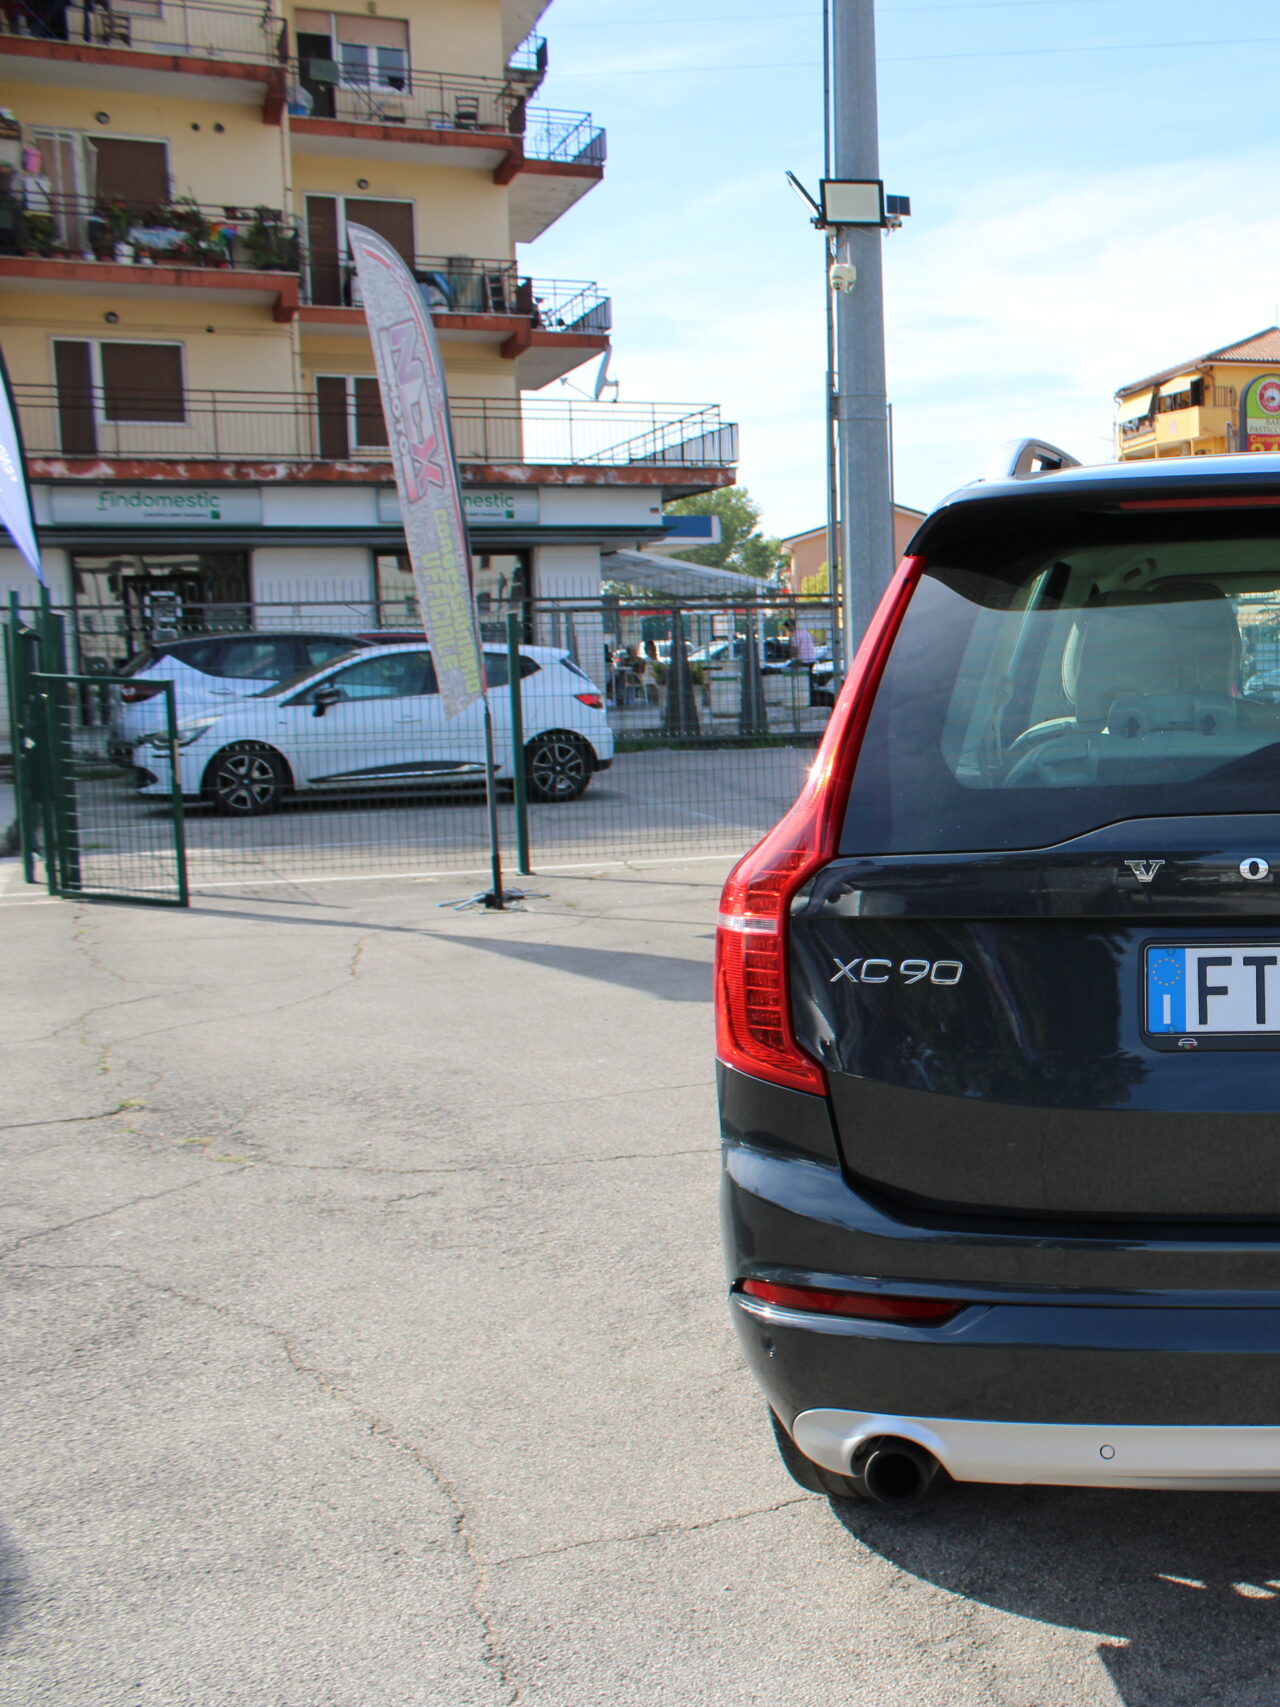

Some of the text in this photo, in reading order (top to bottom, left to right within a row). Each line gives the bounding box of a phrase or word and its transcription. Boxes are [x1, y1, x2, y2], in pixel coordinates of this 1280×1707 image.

[98, 490, 220, 511] Findomestic
[420, 551, 461, 672] UFFICIALE
[830, 957, 964, 986] XC90
[1197, 955, 1278, 1025] FT
